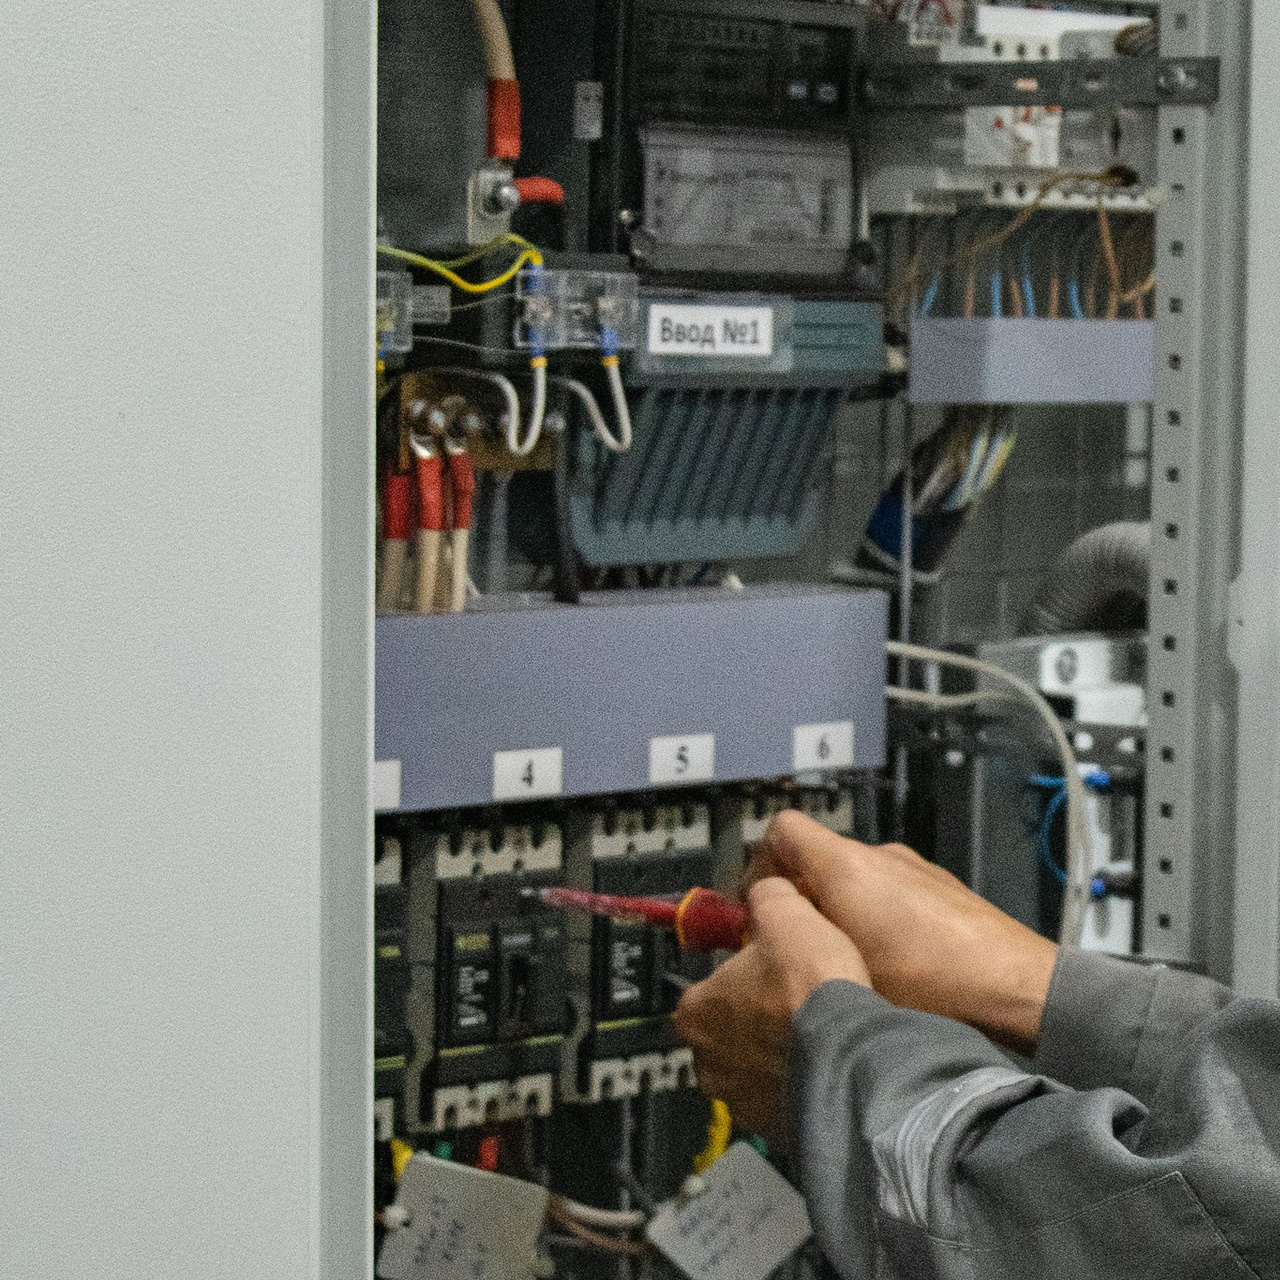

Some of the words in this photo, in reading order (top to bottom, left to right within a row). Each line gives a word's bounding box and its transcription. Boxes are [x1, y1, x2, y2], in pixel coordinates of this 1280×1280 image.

[658, 316, 717, 350] Ввод
[722, 318, 761, 346] №1
[675, 743, 689, 774] 5
[815, 733, 830, 762] 6
[522, 757, 534, 789] 4
